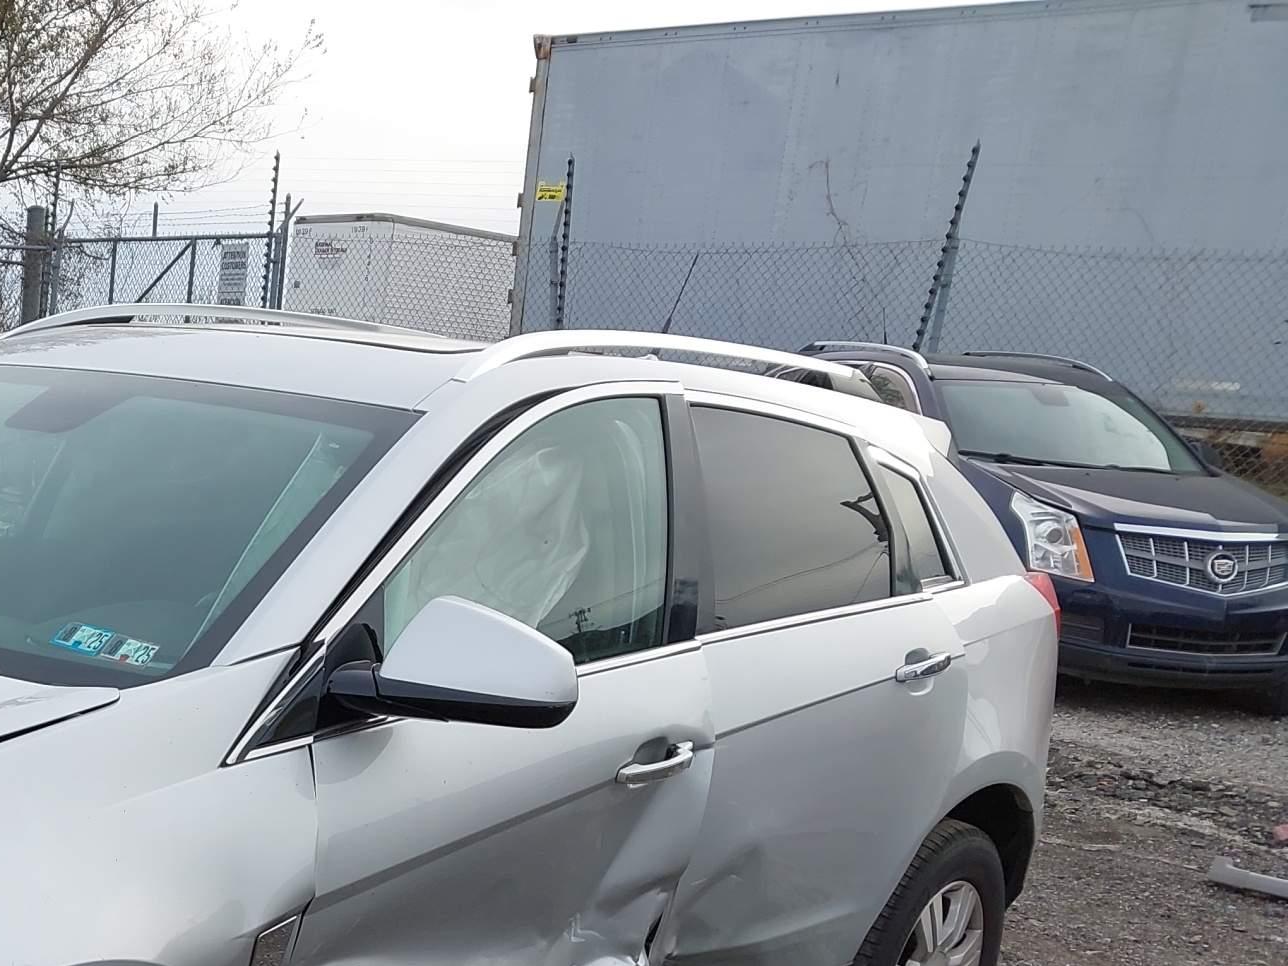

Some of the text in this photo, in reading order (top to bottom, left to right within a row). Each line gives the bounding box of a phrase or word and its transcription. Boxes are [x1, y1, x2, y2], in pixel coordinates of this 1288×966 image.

[221, 262, 247, 270] CUSTOMERS
[87, 632, 109, 650] 25
[135, 645, 156, 664] 25
